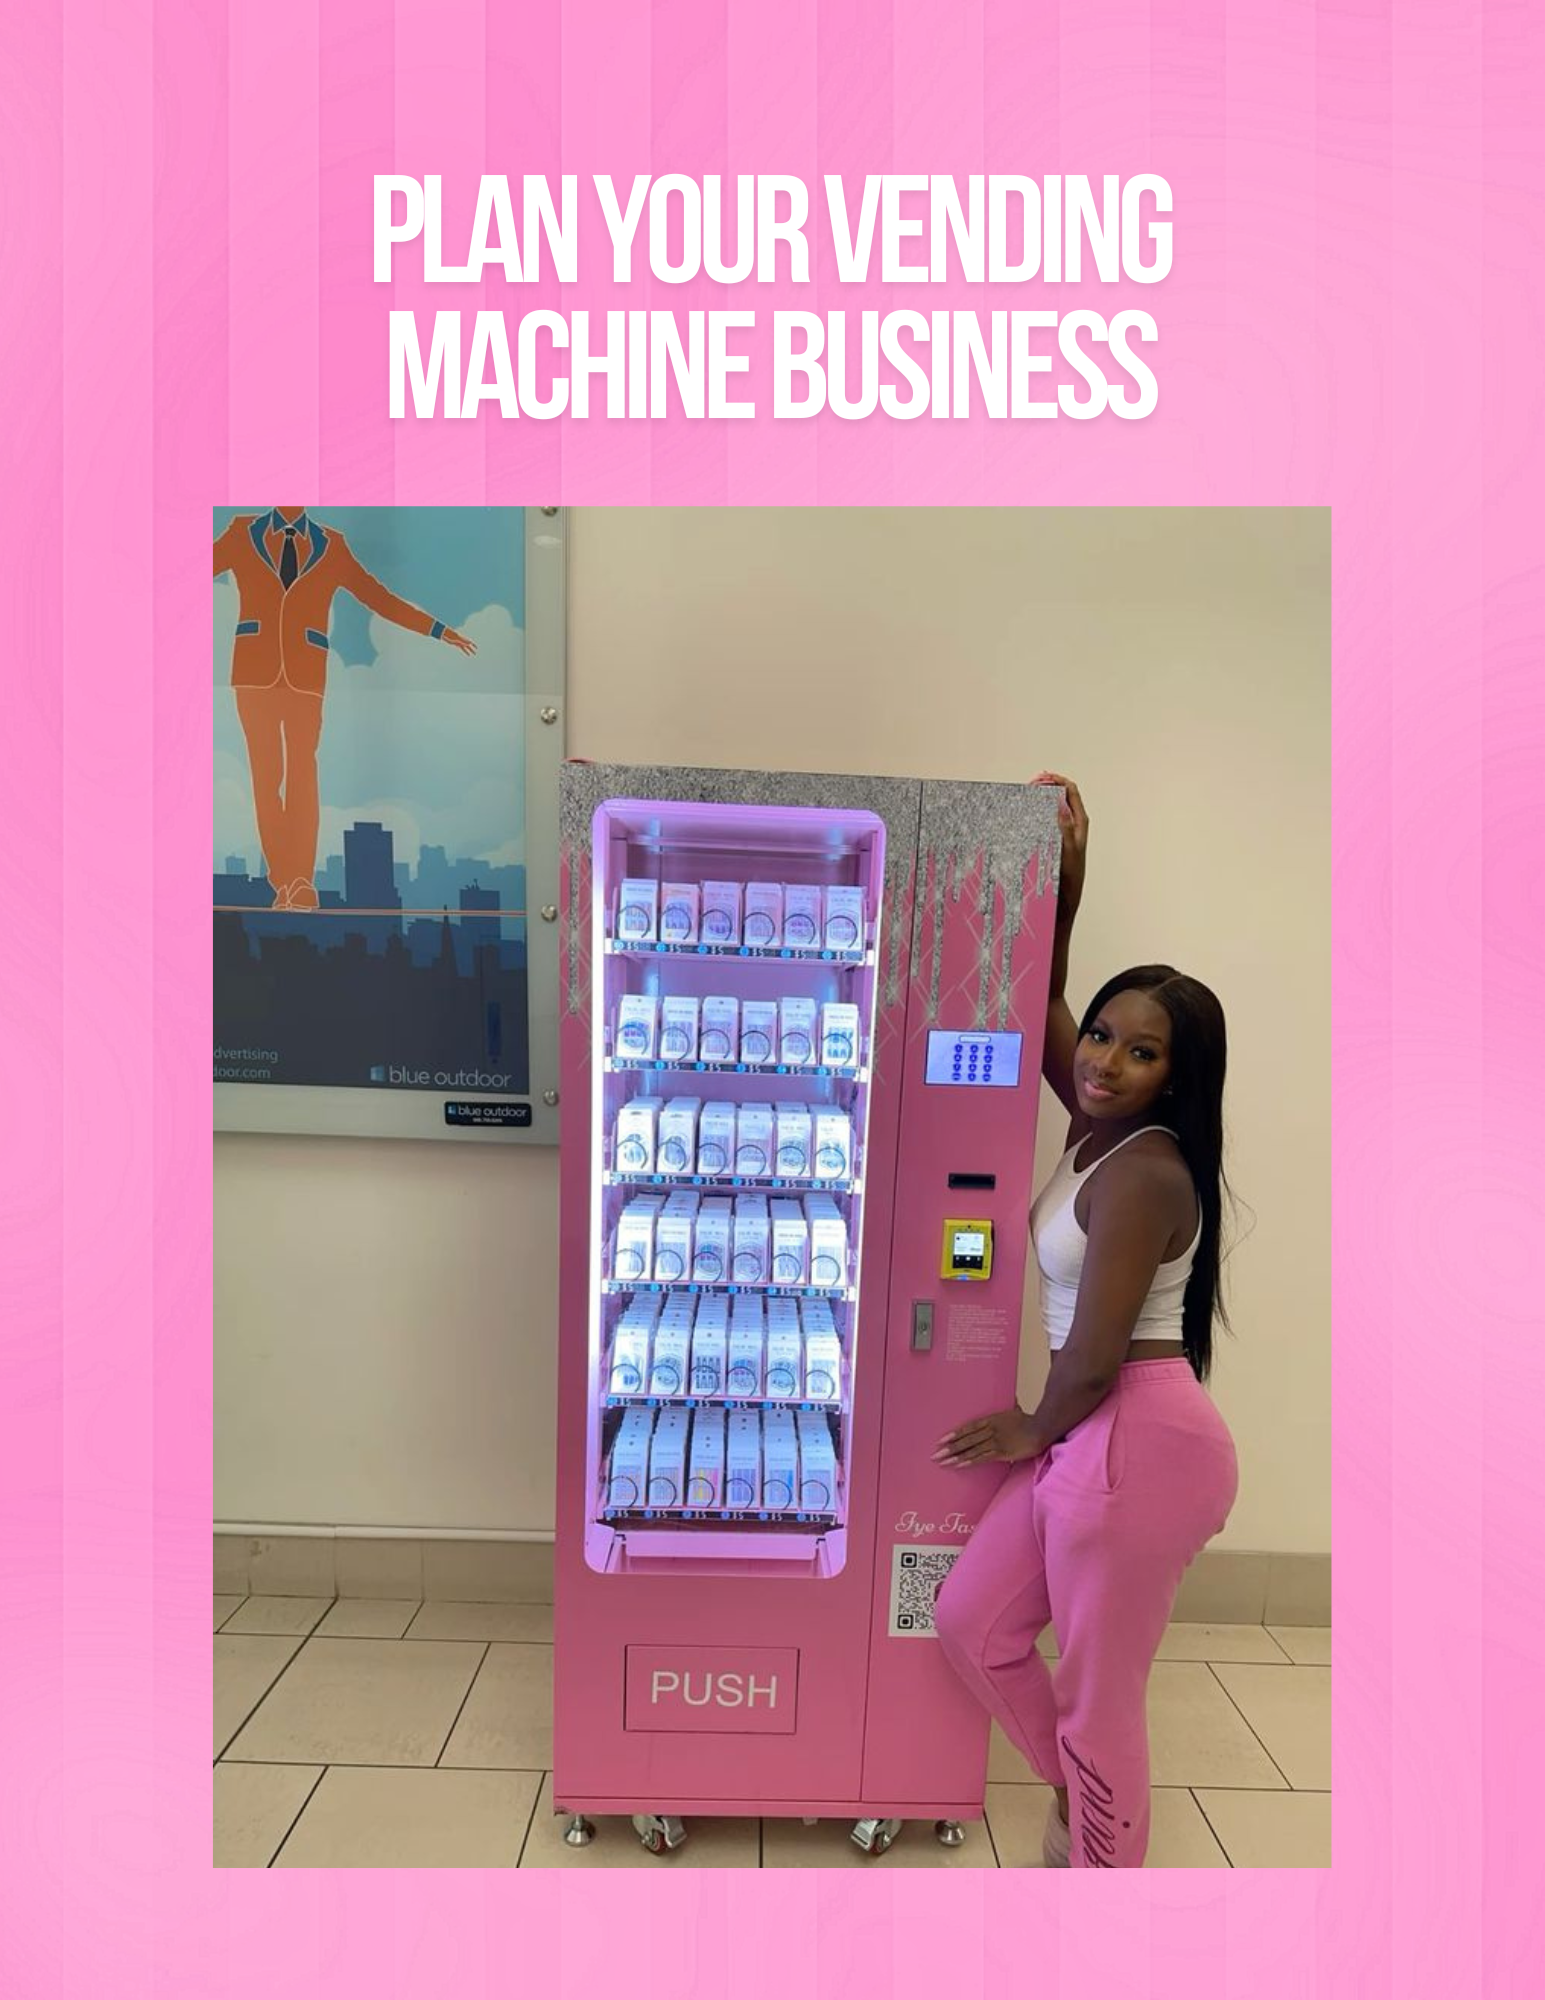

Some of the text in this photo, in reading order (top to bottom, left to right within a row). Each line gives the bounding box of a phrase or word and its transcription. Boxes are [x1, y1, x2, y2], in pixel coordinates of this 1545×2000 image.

[213, 1046, 279, 1063] dvertising
[389, 1065, 512, 1087] blue outdoor
[458, 1105, 527, 1117] blue outdoor
[651, 1670, 778, 1708] PUSH
